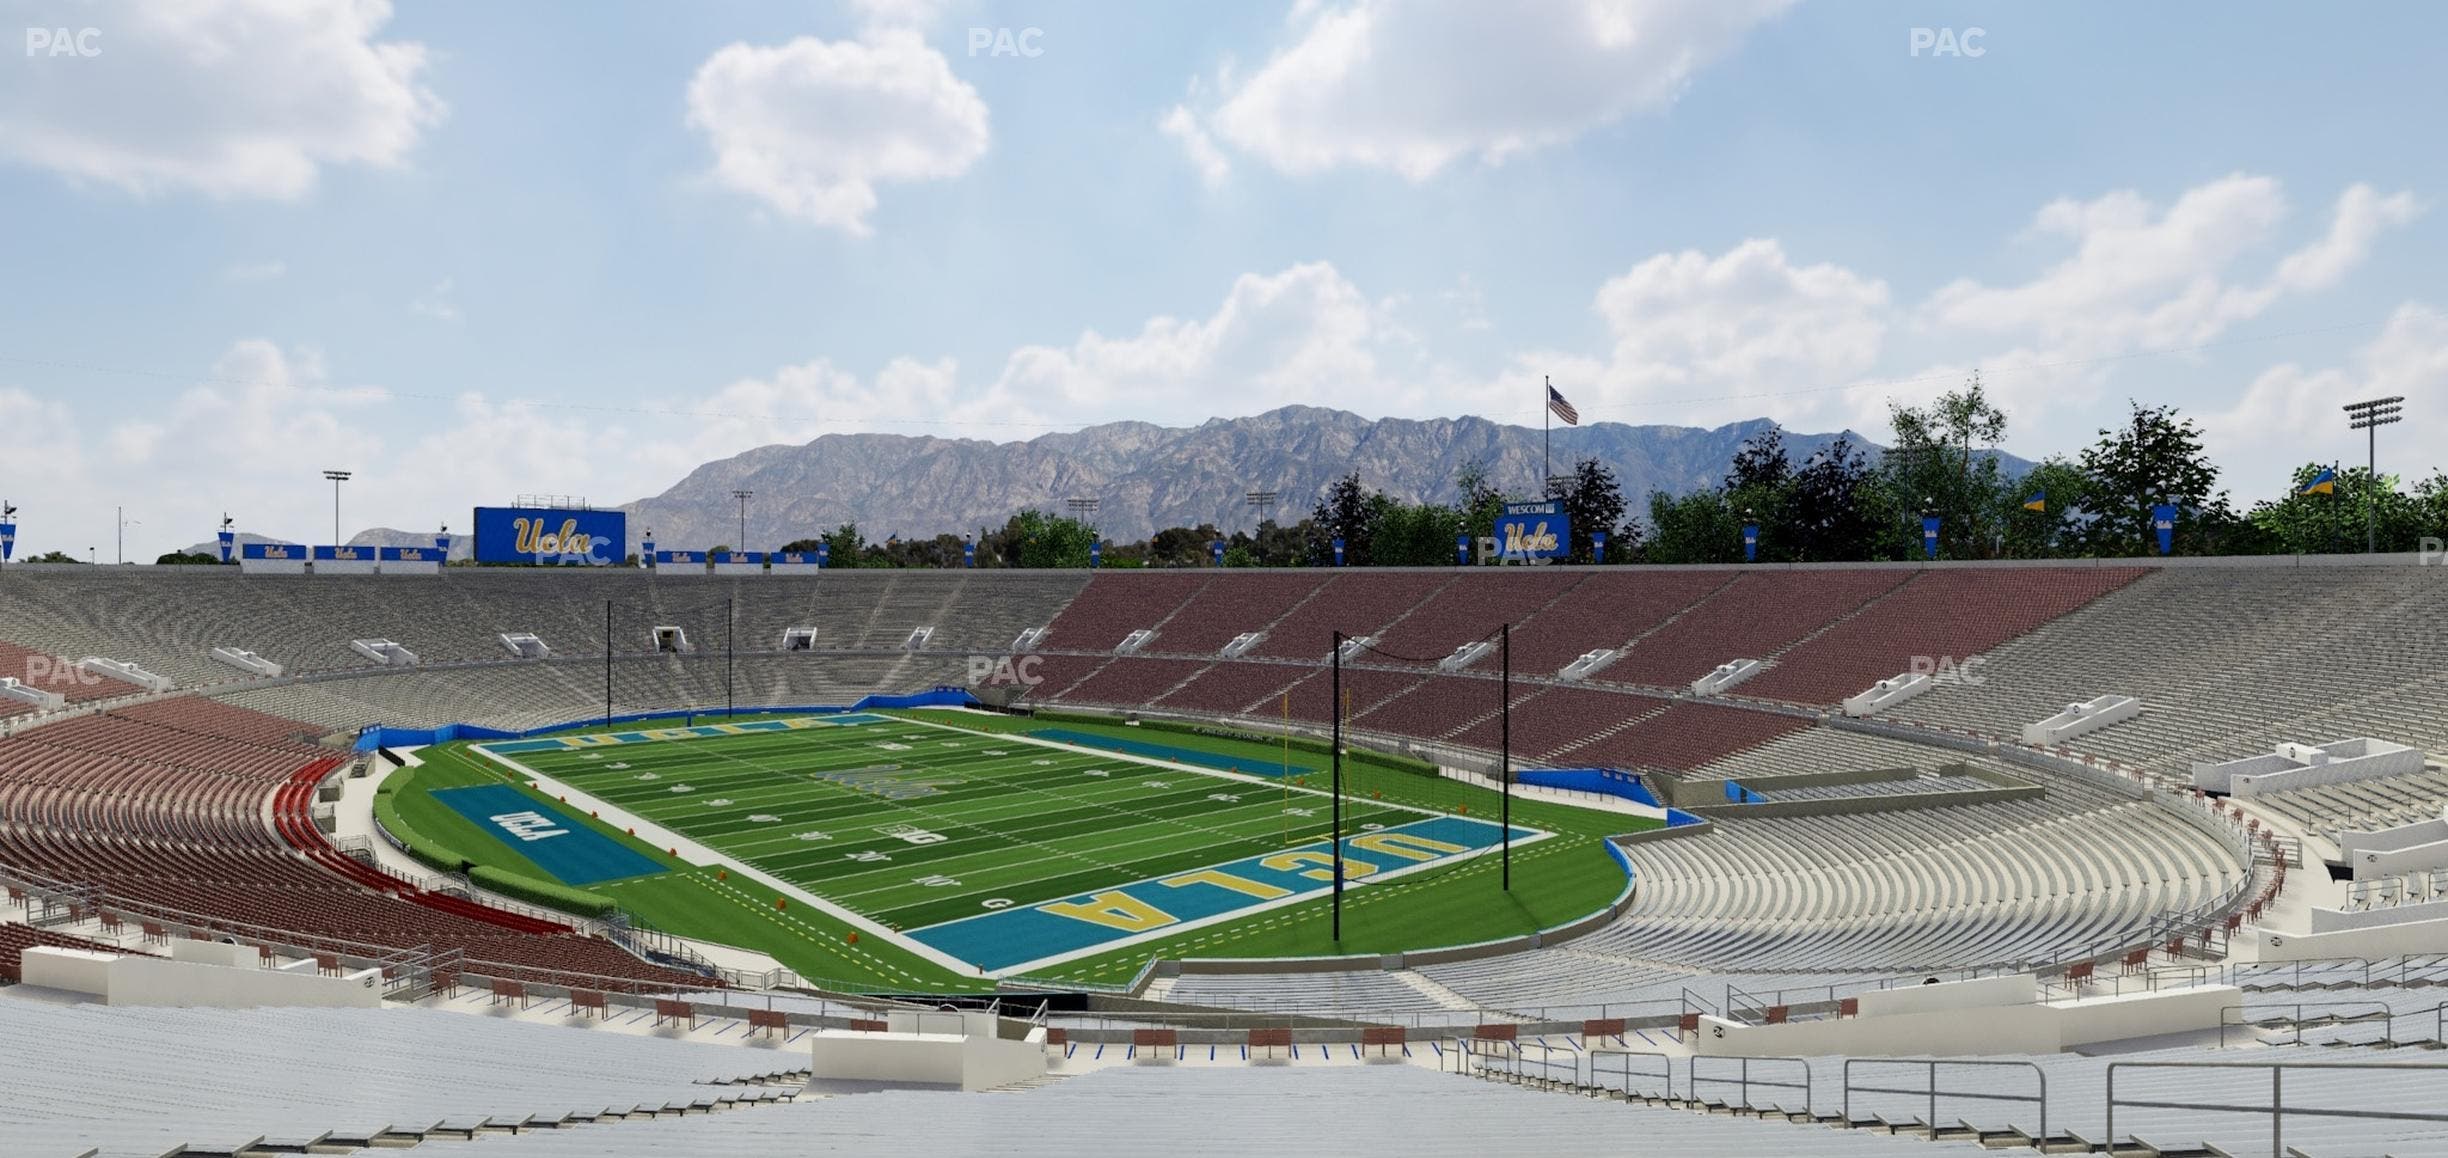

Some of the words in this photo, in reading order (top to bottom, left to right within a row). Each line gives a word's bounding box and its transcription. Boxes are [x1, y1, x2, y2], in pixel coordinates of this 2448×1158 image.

[1508, 503, 1545, 515] WESCOM
[513, 517, 593, 554] Ucla
[1504, 522, 1560, 551] Ucla
[490, 811, 571, 842] UCLA
[1035, 832, 1468, 933] UCLA
[981, 898, 1015, 909] G
